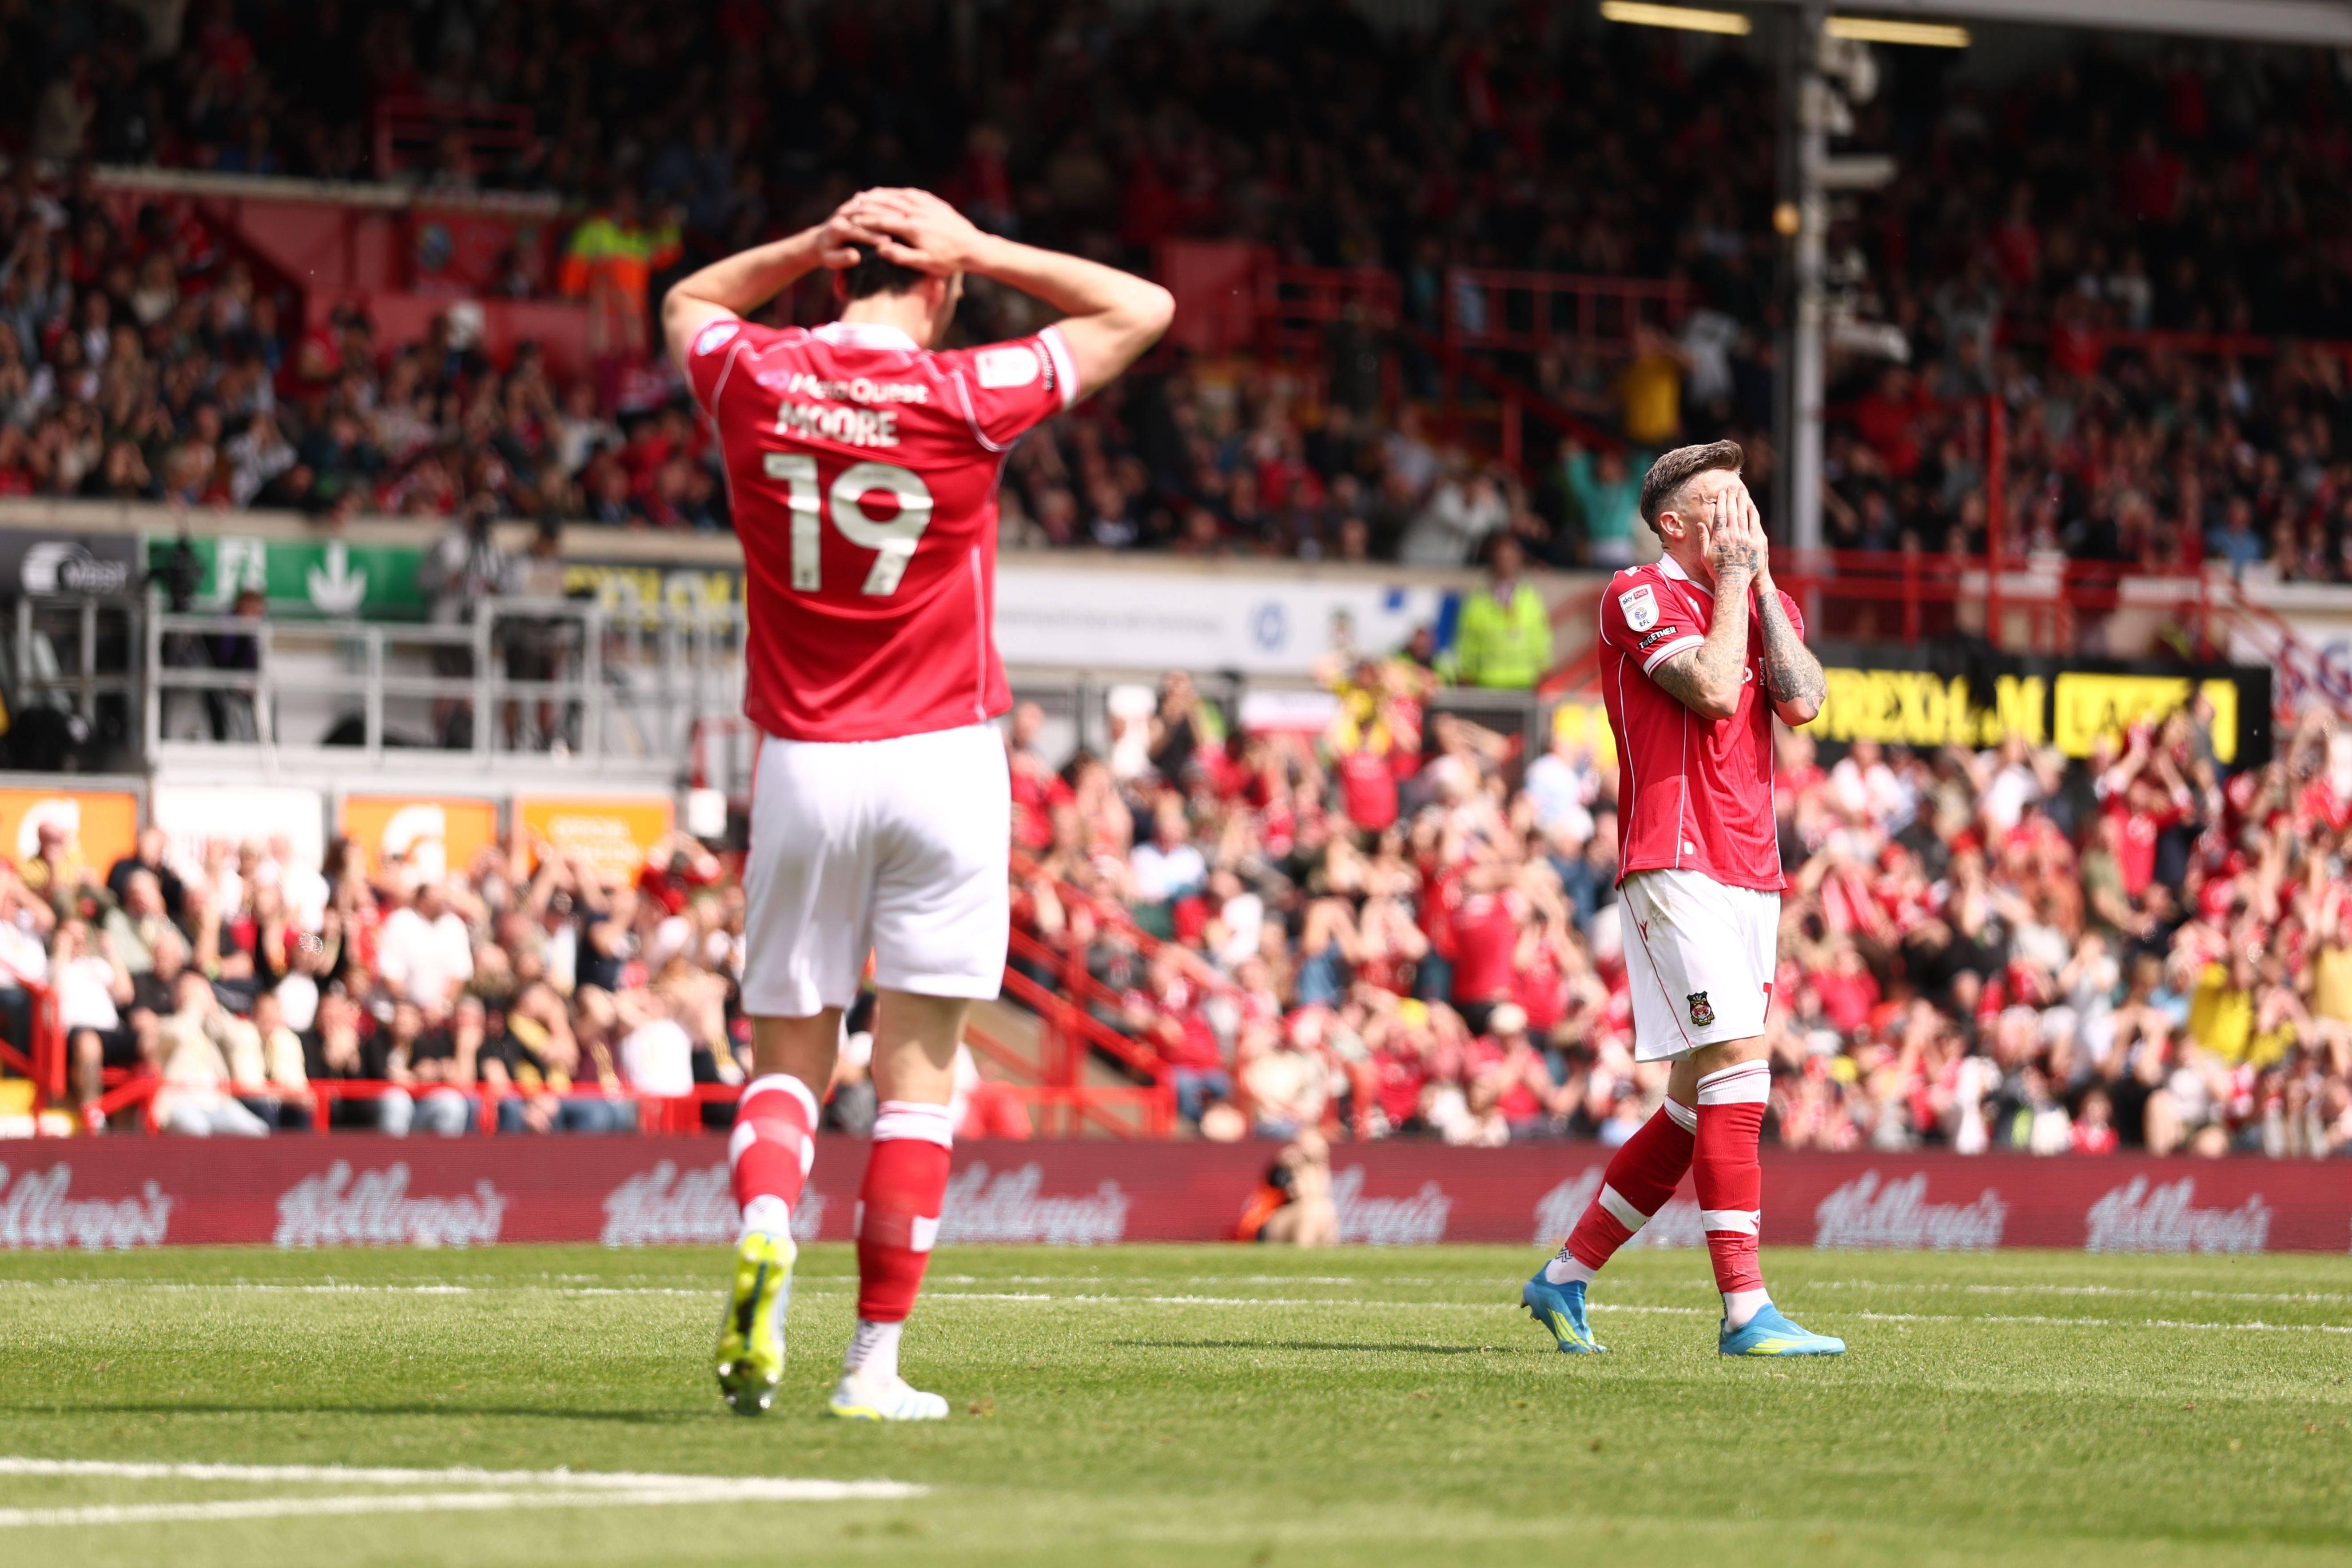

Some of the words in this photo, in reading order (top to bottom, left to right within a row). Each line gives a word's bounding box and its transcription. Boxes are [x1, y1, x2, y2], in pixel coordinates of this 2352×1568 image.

[775, 401, 900, 447] MOORE
[763, 452, 934, 596] 19
[1634, 589, 1648, 598] bet
[1638, 626, 1677, 649] TOGETHER
